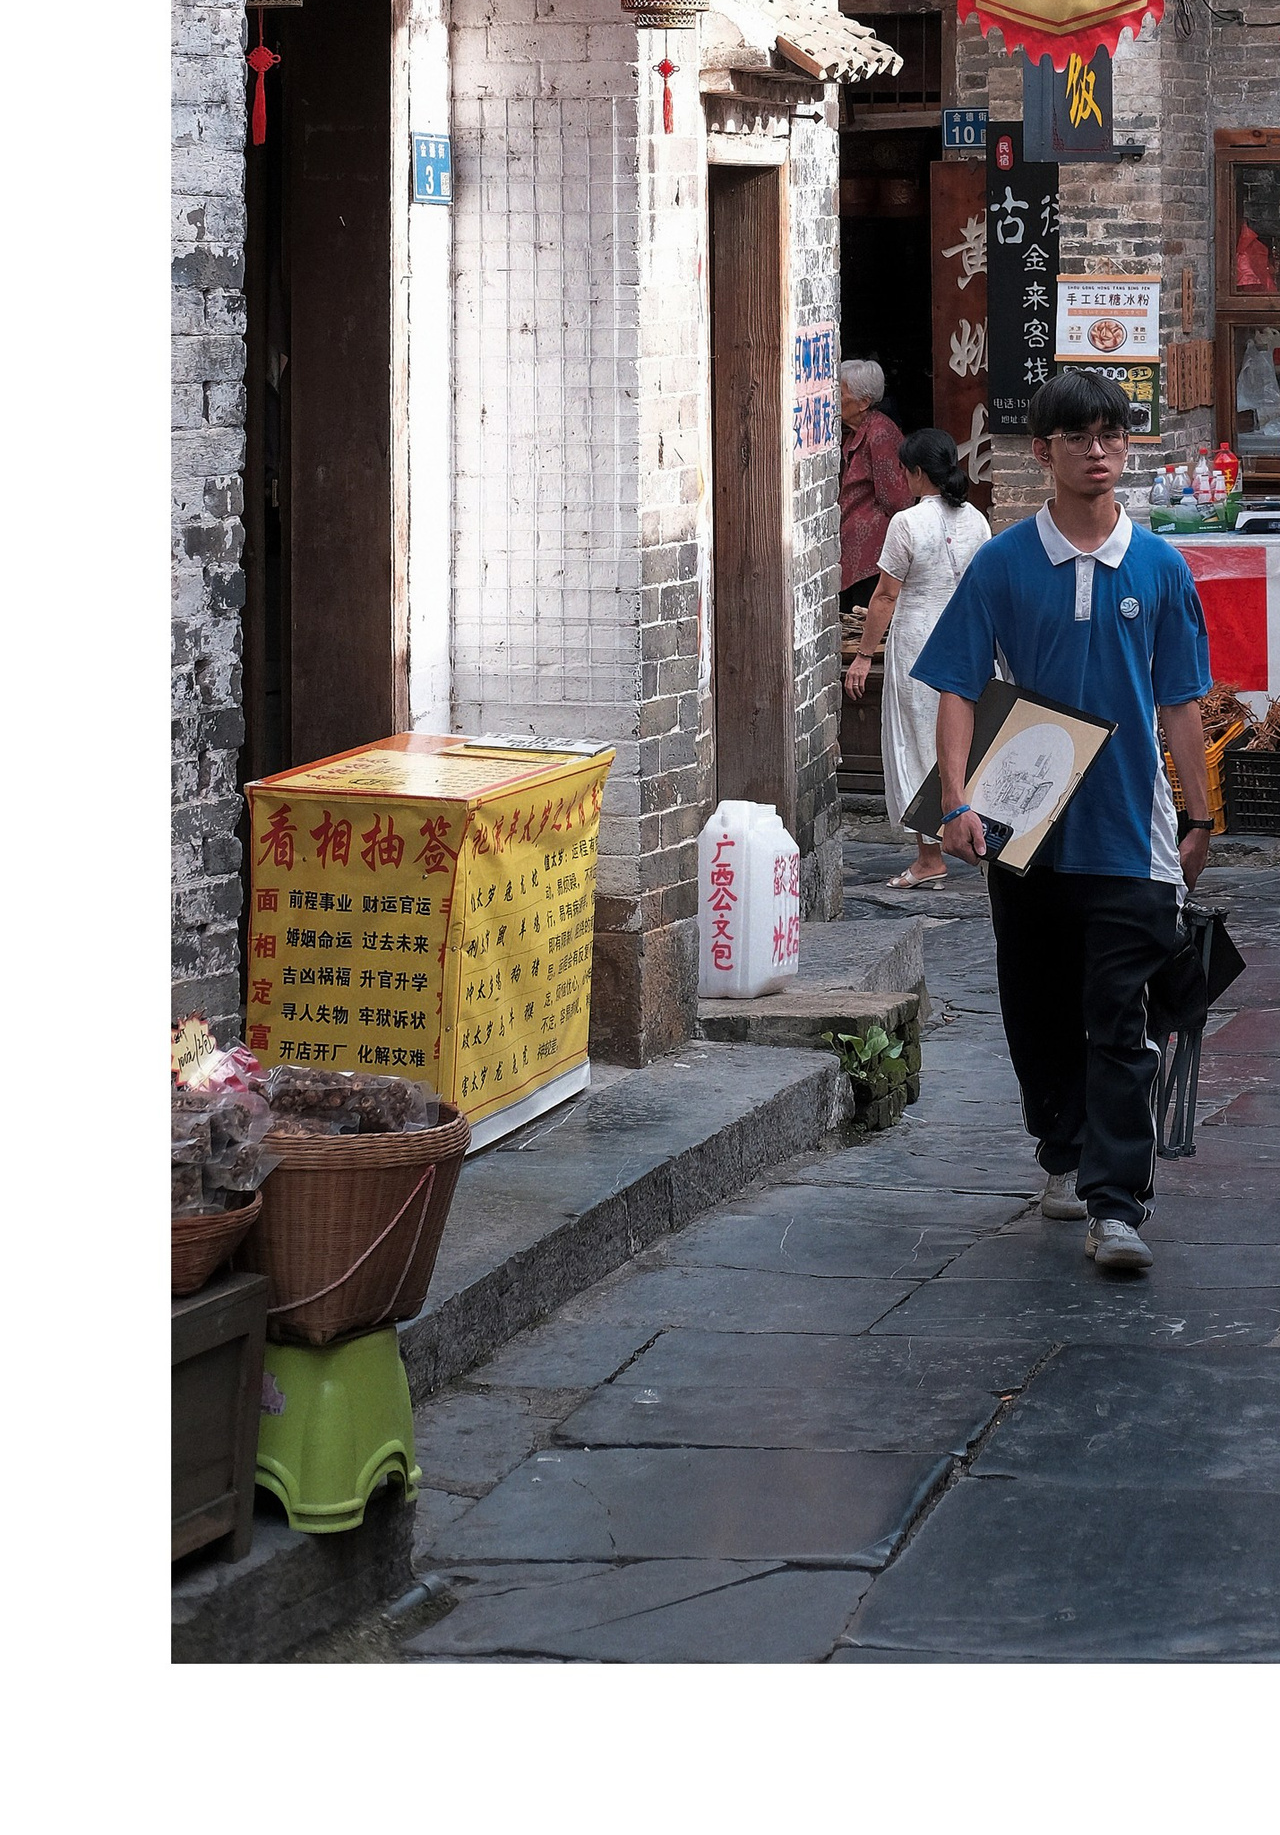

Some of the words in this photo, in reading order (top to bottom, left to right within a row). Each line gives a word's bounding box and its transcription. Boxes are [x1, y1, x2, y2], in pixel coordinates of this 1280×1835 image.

[951, 126, 975, 144] 10
[425, 164, 435, 194] 3
[1067, 293, 1150, 306] 手工红糖冰粉
[257, 803, 460, 876] 看相抽签
[288, 889, 353, 913] 前程事业
[362, 895, 432, 916] 财运官运
[707, 834, 738, 971] 广西公文包
[286, 927, 353, 949] 婚姻命运
[362, 931, 429, 955] 过去未来
[249, 888, 281, 1052] 面相定富
[282, 966, 352, 987] 吉凶祸福
[359, 969, 428, 993] 升官升学
[280, 1002, 349, 1025] 寻人失物
[358, 1006, 427, 1030] 牢狱诉状
[279, 1040, 348, 1062] 开店开厂
[357, 1044, 426, 1068] 化解灾难
